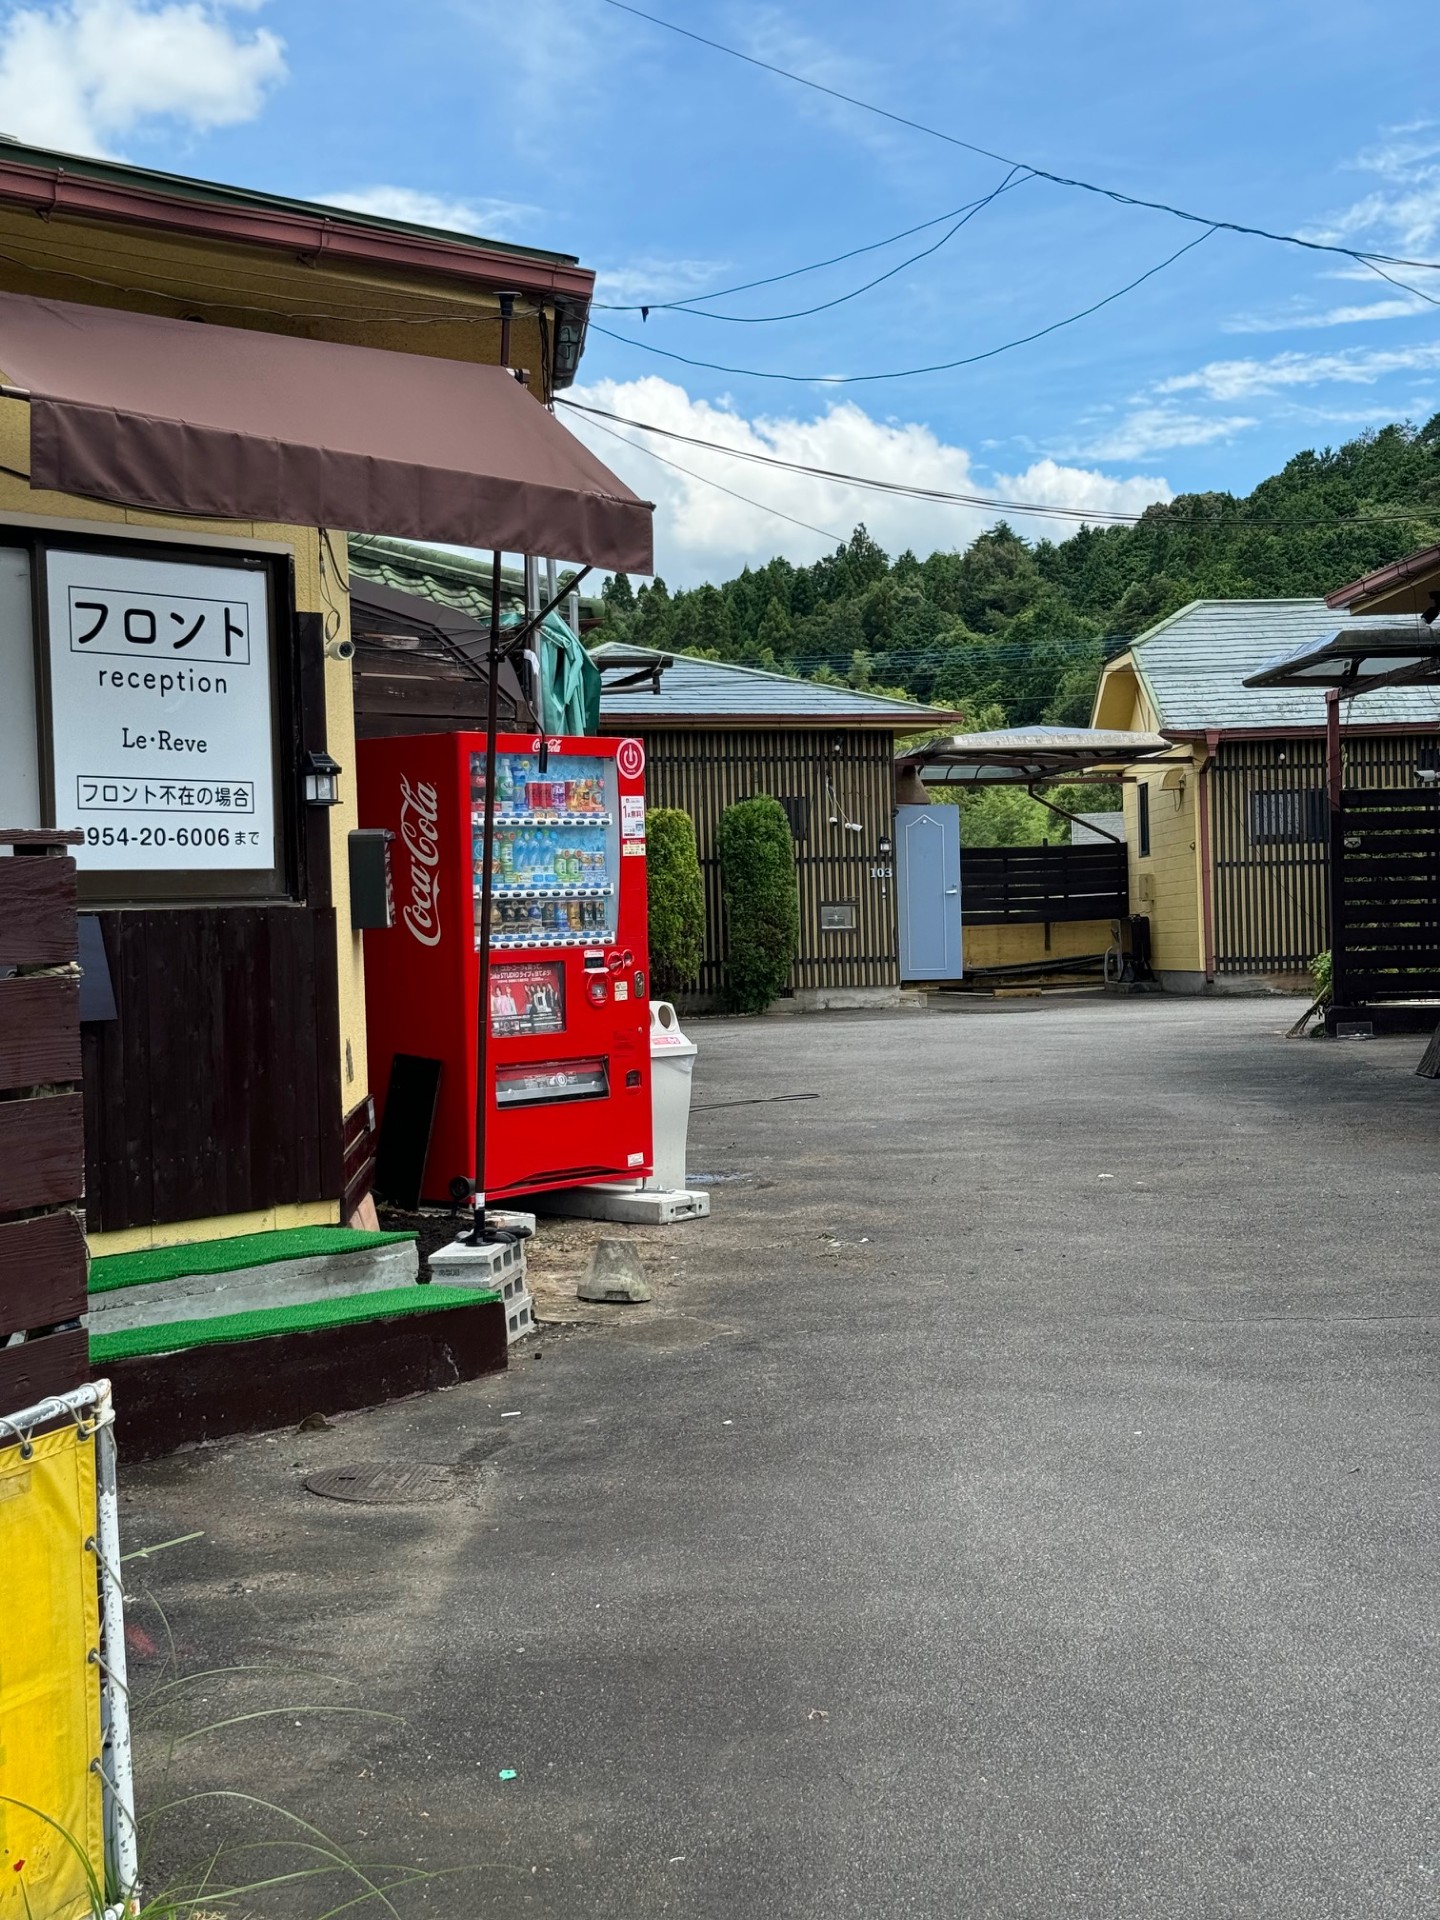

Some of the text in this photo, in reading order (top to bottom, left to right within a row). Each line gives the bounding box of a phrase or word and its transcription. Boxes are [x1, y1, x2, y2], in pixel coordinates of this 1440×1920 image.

[74, 600, 244, 657] フロント
[98, 668, 228, 698] reception
[82, 784, 250, 808] フロント不在の場合
[77, 826, 260, 847] 954-20-6006まで
[400, 773, 441, 947] Coca-Cola
[870, 867, 893, 878] 103
